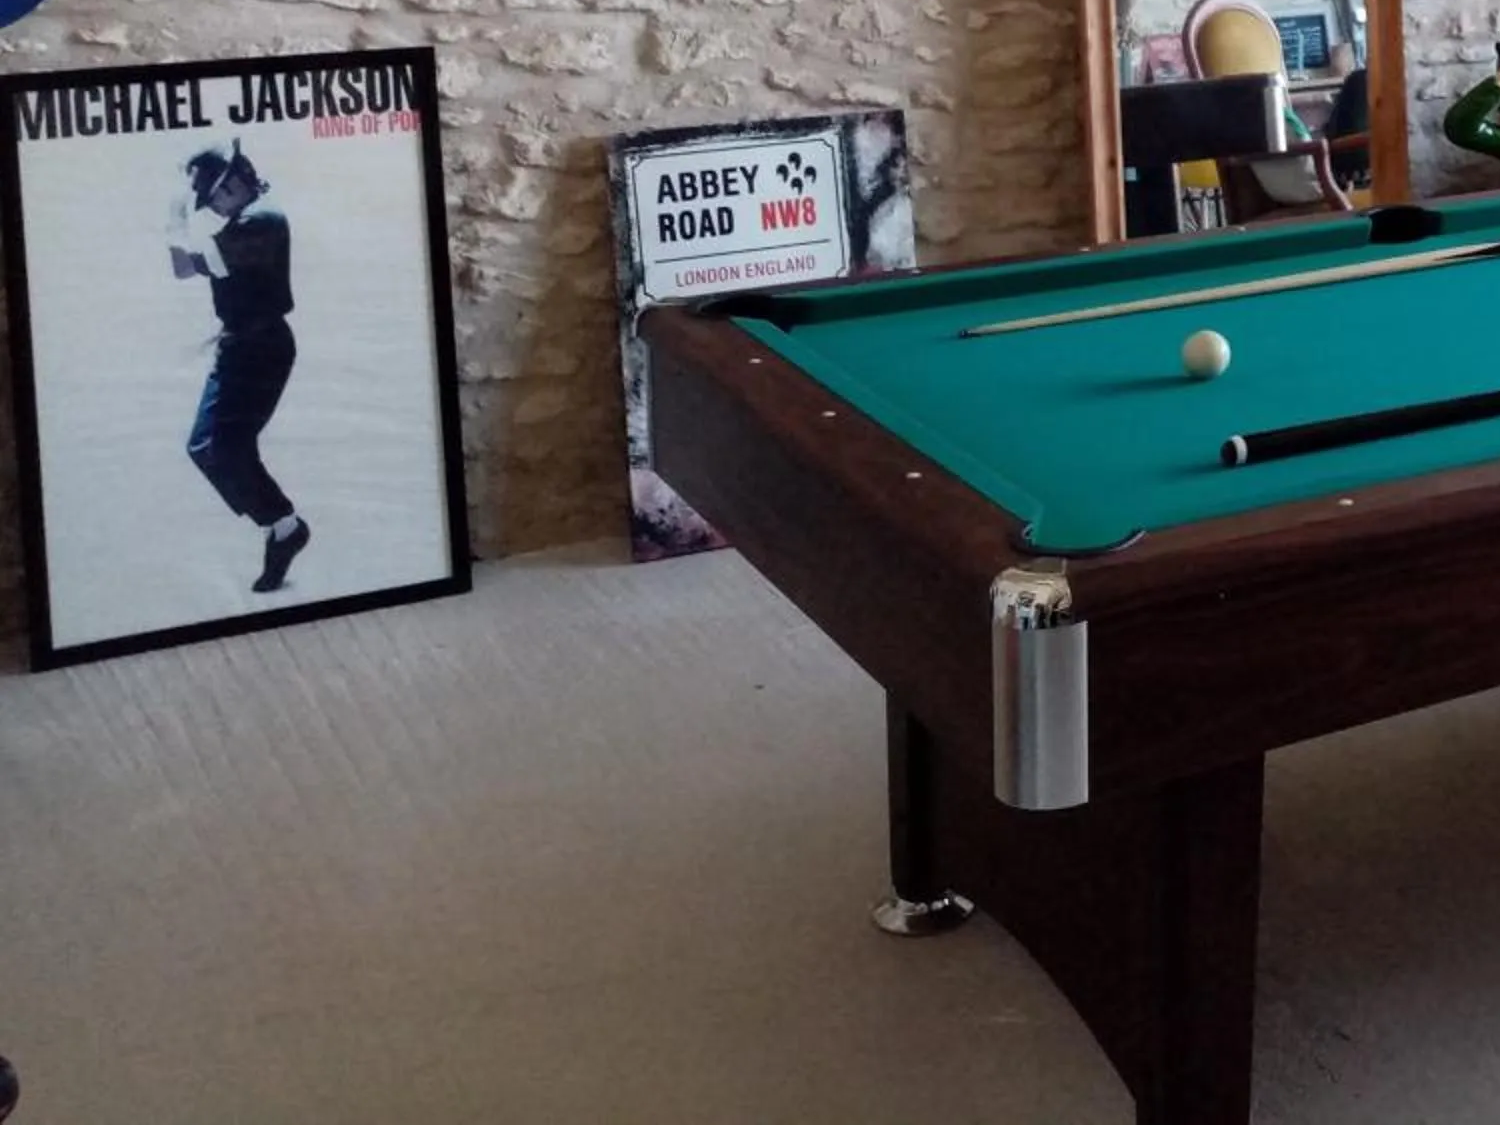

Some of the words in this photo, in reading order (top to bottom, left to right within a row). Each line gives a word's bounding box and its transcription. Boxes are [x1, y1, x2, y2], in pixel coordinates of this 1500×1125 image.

[15, 78, 212, 141] MICHAEL
[228, 62, 419, 125] JACKSON
[314, 116, 356, 139] KING
[361, 114, 381, 134] OF
[657, 164, 759, 204] ABBEY
[658, 206, 734, 243] ROAD
[761, 197, 816, 231] NW8
[675, 267, 740, 287] LONDON
[744, 254, 816, 277] ENGLAND
